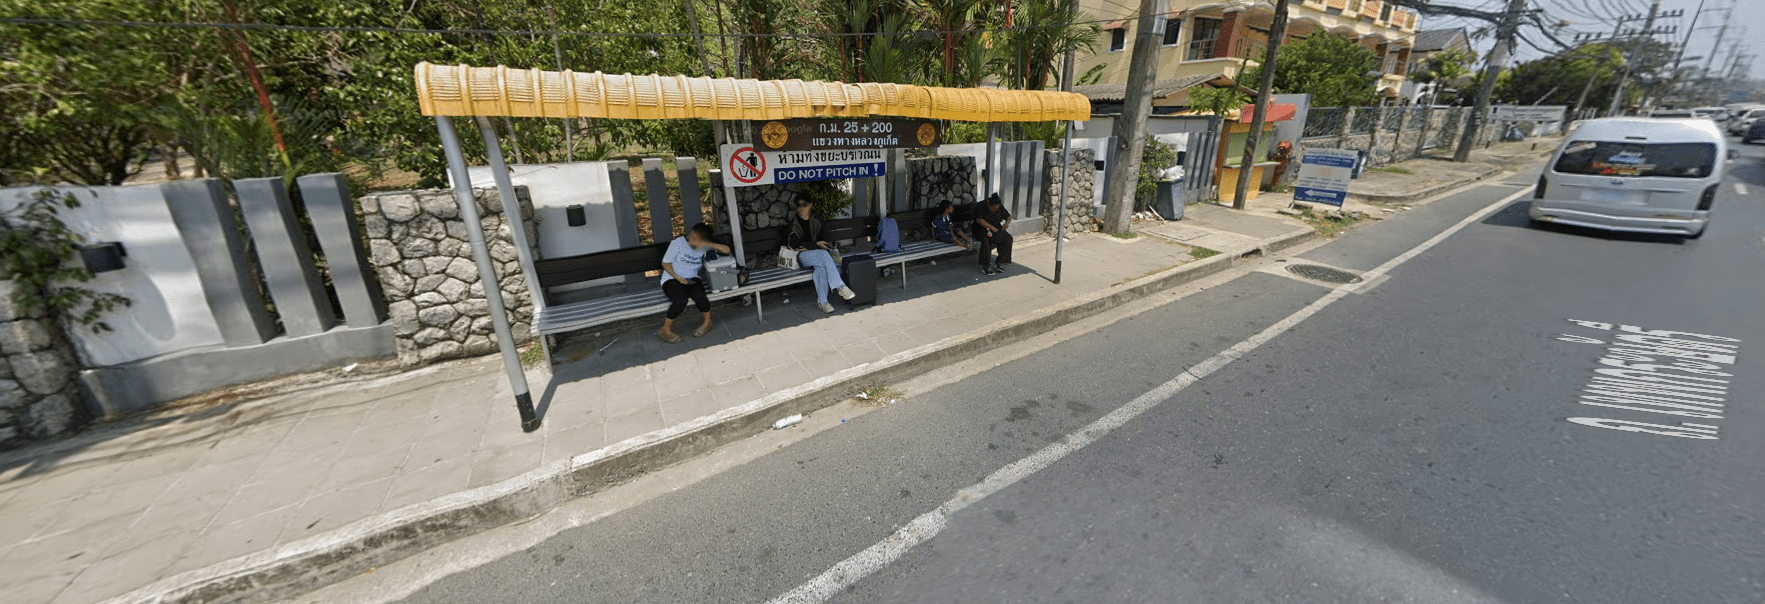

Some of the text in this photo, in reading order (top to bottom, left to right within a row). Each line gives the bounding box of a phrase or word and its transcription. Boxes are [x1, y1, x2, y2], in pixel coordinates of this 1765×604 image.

[843, 121, 859, 133] 25
[861, 123, 869, 133] +
[871, 121, 893, 133] 200
[778, 170, 796, 181] DO
[798, 168, 823, 179] NOT
[826, 166, 856, 177] PITCH
[859, 166, 869, 175] IN
